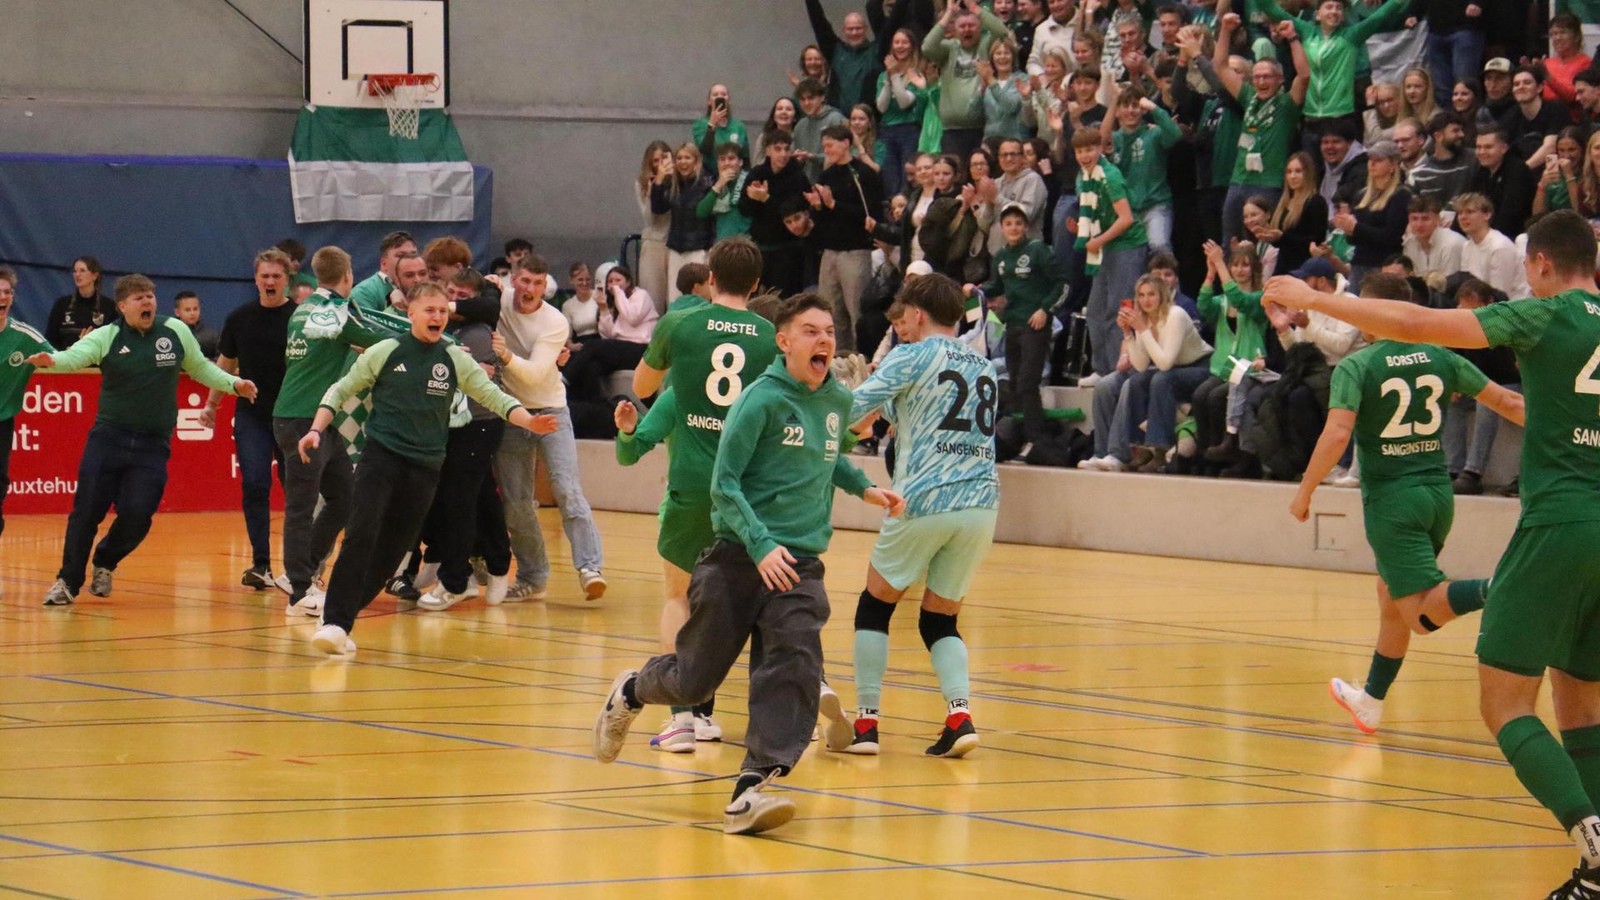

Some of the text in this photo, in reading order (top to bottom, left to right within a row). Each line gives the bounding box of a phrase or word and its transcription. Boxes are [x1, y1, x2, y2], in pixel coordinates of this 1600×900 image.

[707, 319, 759, 336] BORSTEL
[155, 352, 176, 360] ERGO
[946, 350, 988, 366] BORSTEL
[1385, 352, 1431, 367] BORSTEL
[705, 342, 746, 407] 8
[427, 380, 450, 390] ERGO
[22, 384, 82, 414] den
[937, 369, 997, 437] 28
[1380, 374, 1444, 438] 23
[782, 426, 804, 447] 22
